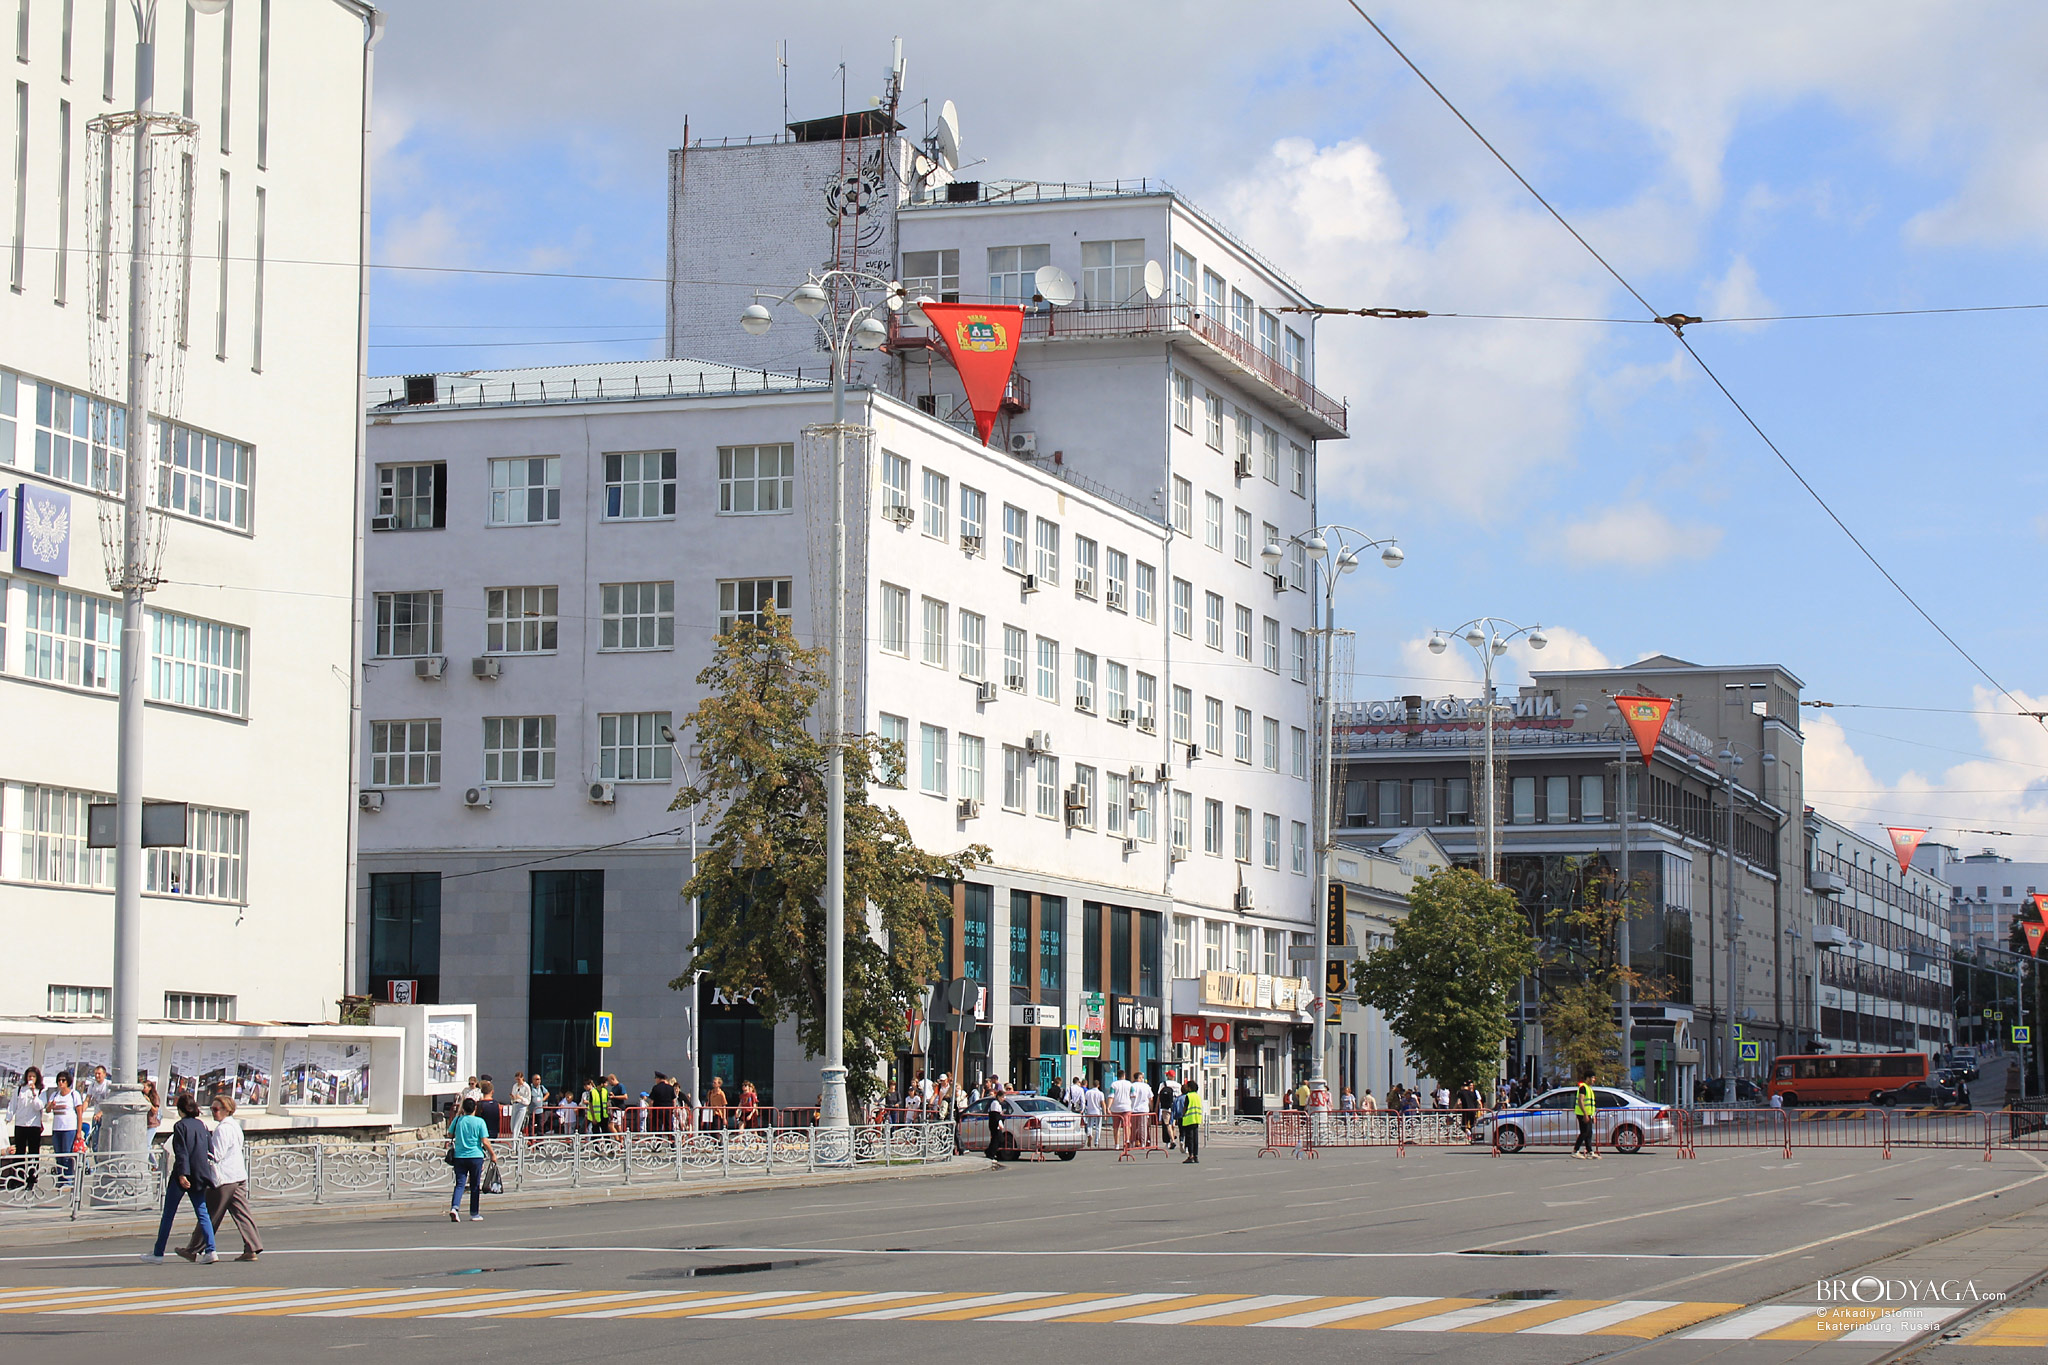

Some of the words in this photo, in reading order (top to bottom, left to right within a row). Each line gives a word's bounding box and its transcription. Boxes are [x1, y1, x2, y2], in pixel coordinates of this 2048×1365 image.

[865, 260, 891, 273] EVERY
[1318, 696, 1407, 722] ЬНОЙ
[1118, 1004, 1134, 1028] VIET
